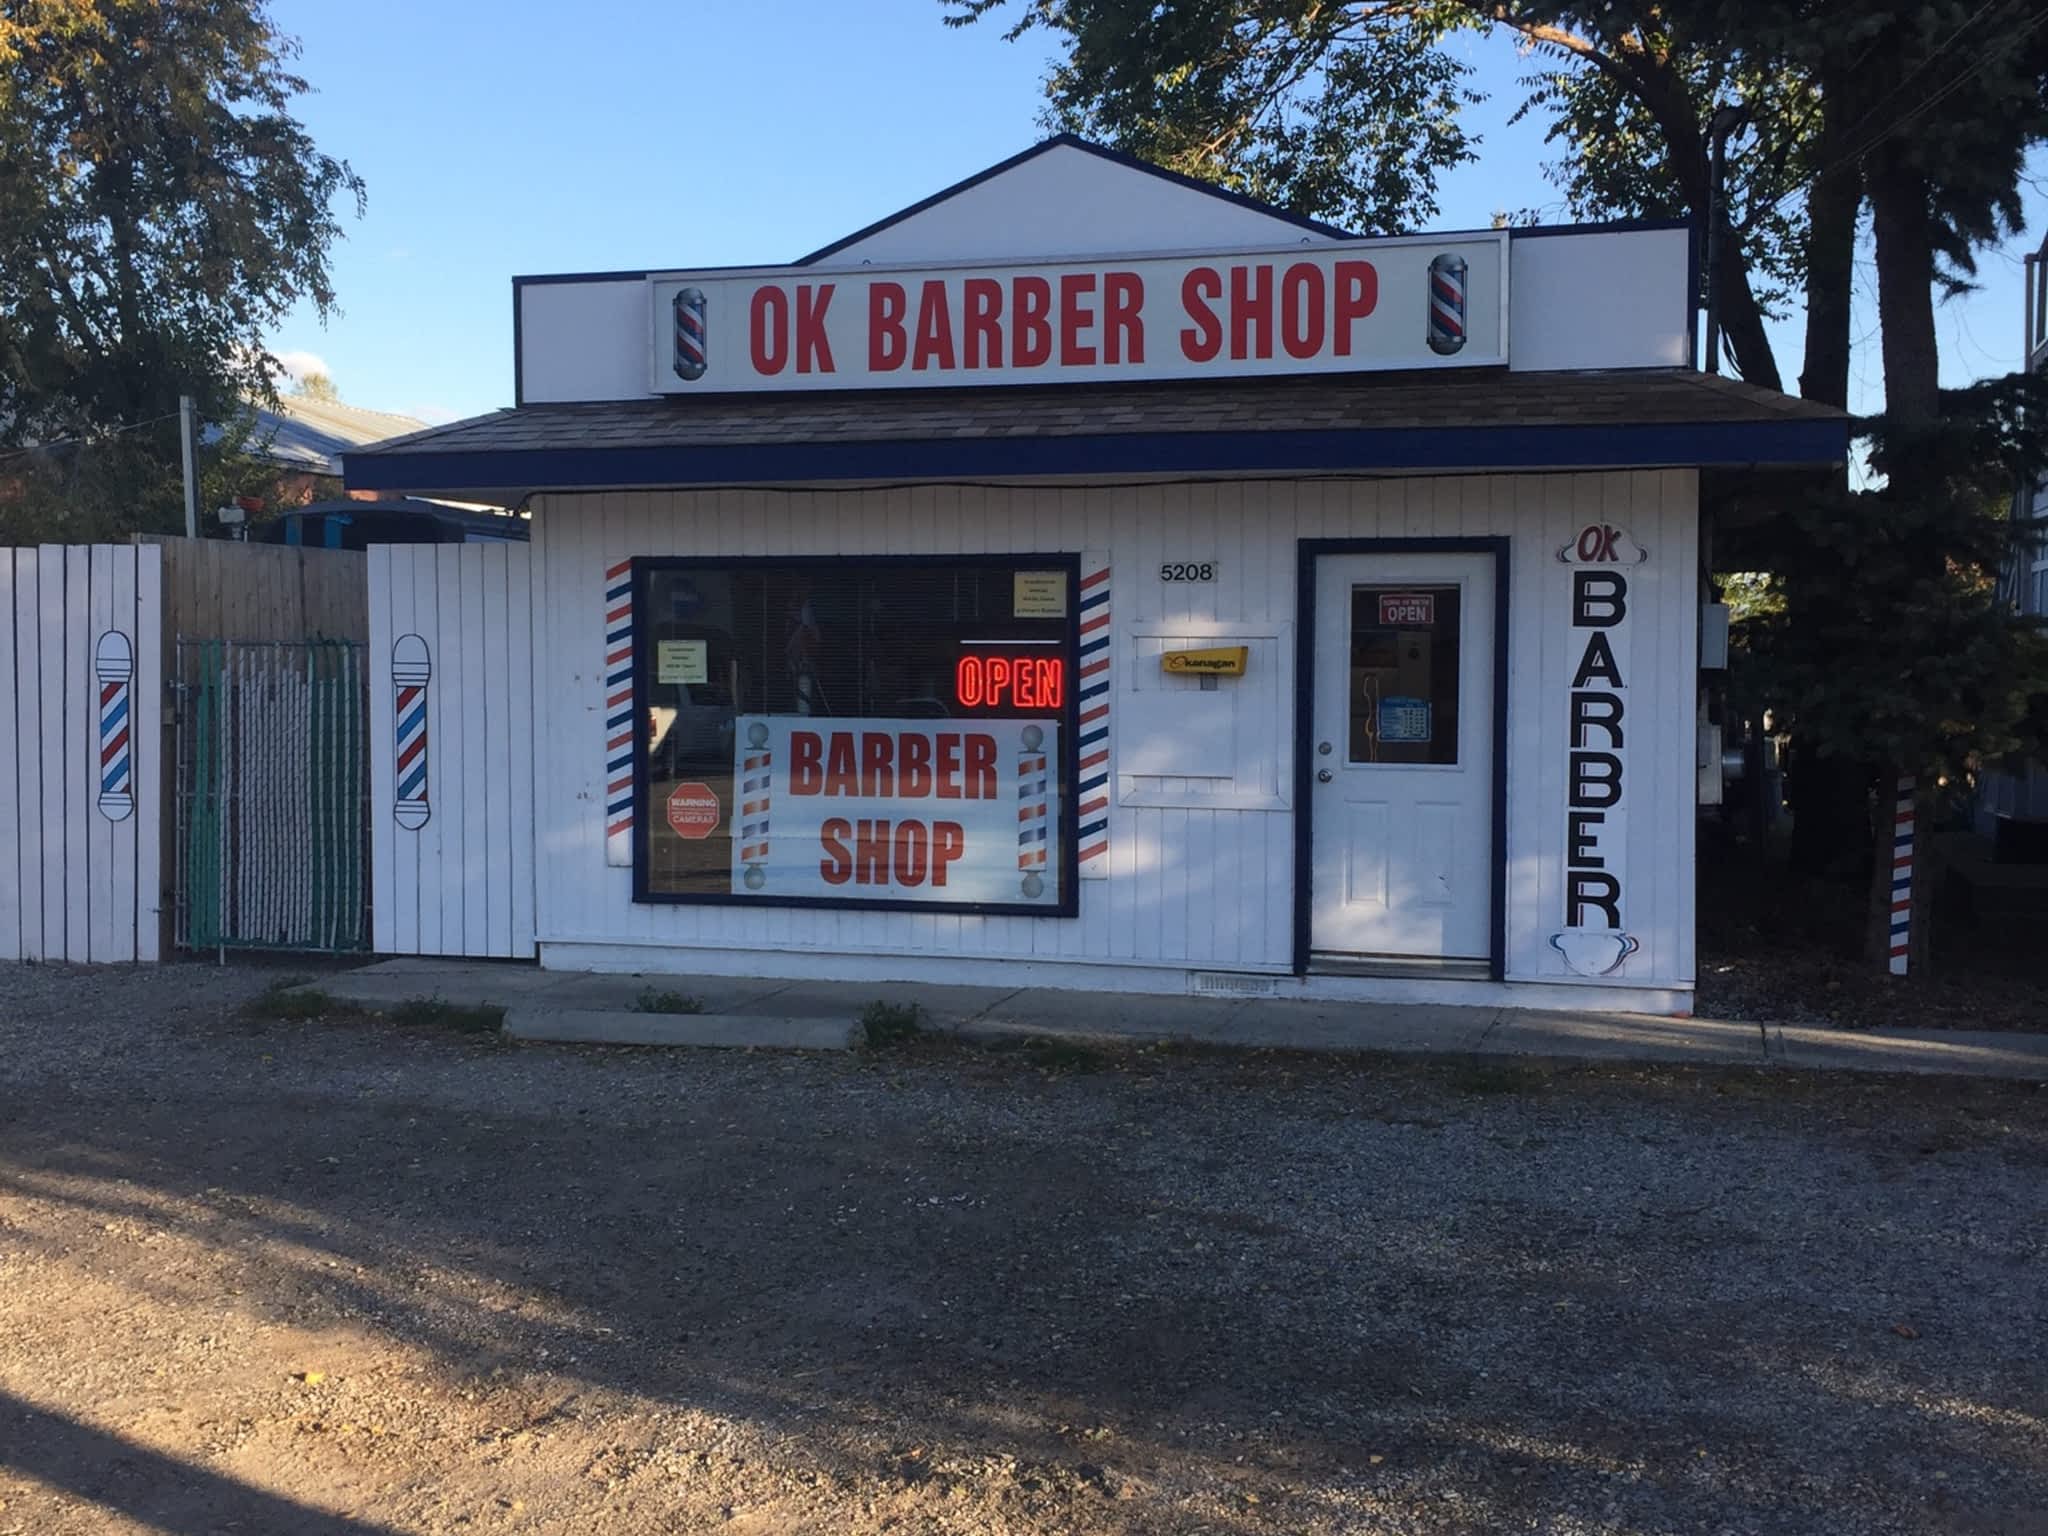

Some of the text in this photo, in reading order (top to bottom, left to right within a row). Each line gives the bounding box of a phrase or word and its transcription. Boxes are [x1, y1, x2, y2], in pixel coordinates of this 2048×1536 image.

[750, 261, 1378, 375] OK BARBER SHOP
[1577, 525, 1621, 562] OK
[1161, 563, 1212, 581] 5208
[1388, 606, 1426, 621] OPEN
[957, 656, 1062, 708] OPEN
[788, 730, 998, 801] BARBER
[1567, 570, 1627, 928] BARBER
[671, 798, 716, 807] WARNING
[820, 817, 964, 887] SHOP
